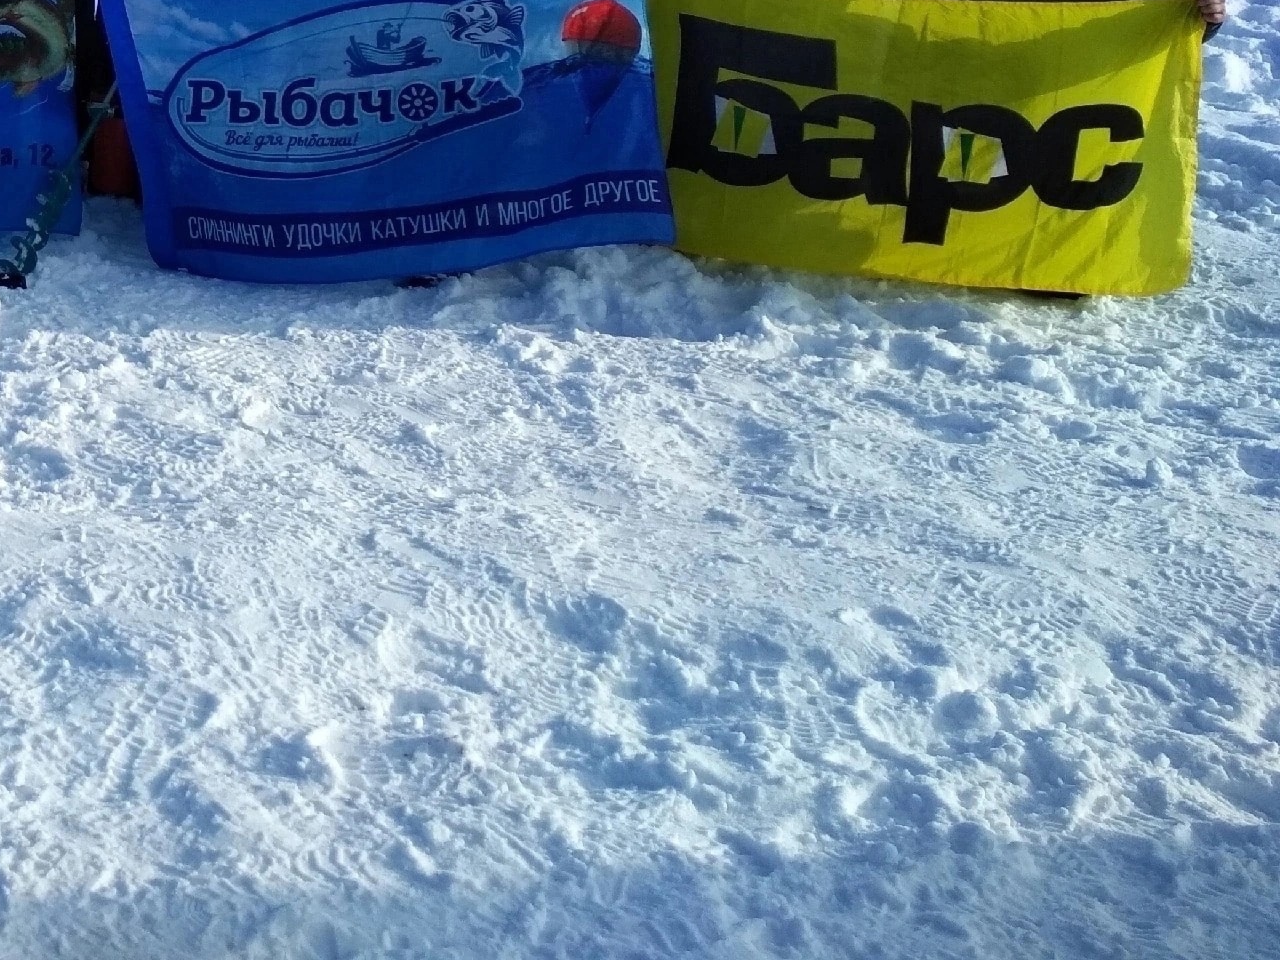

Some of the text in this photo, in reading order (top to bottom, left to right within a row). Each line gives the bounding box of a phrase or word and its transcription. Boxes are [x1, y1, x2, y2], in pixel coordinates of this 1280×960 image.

[185, 77, 478, 127] Рыбачок
[225, 130, 360, 152] Всё для рыбалки!
[666, 14, 1144, 245] Барс
[26, 142, 55, 168] 12
[188, 179, 663, 250] СПИННИНГИ УДОЧКИ КАТУШКИ И МНОГОЕ ДРУГОЕ
